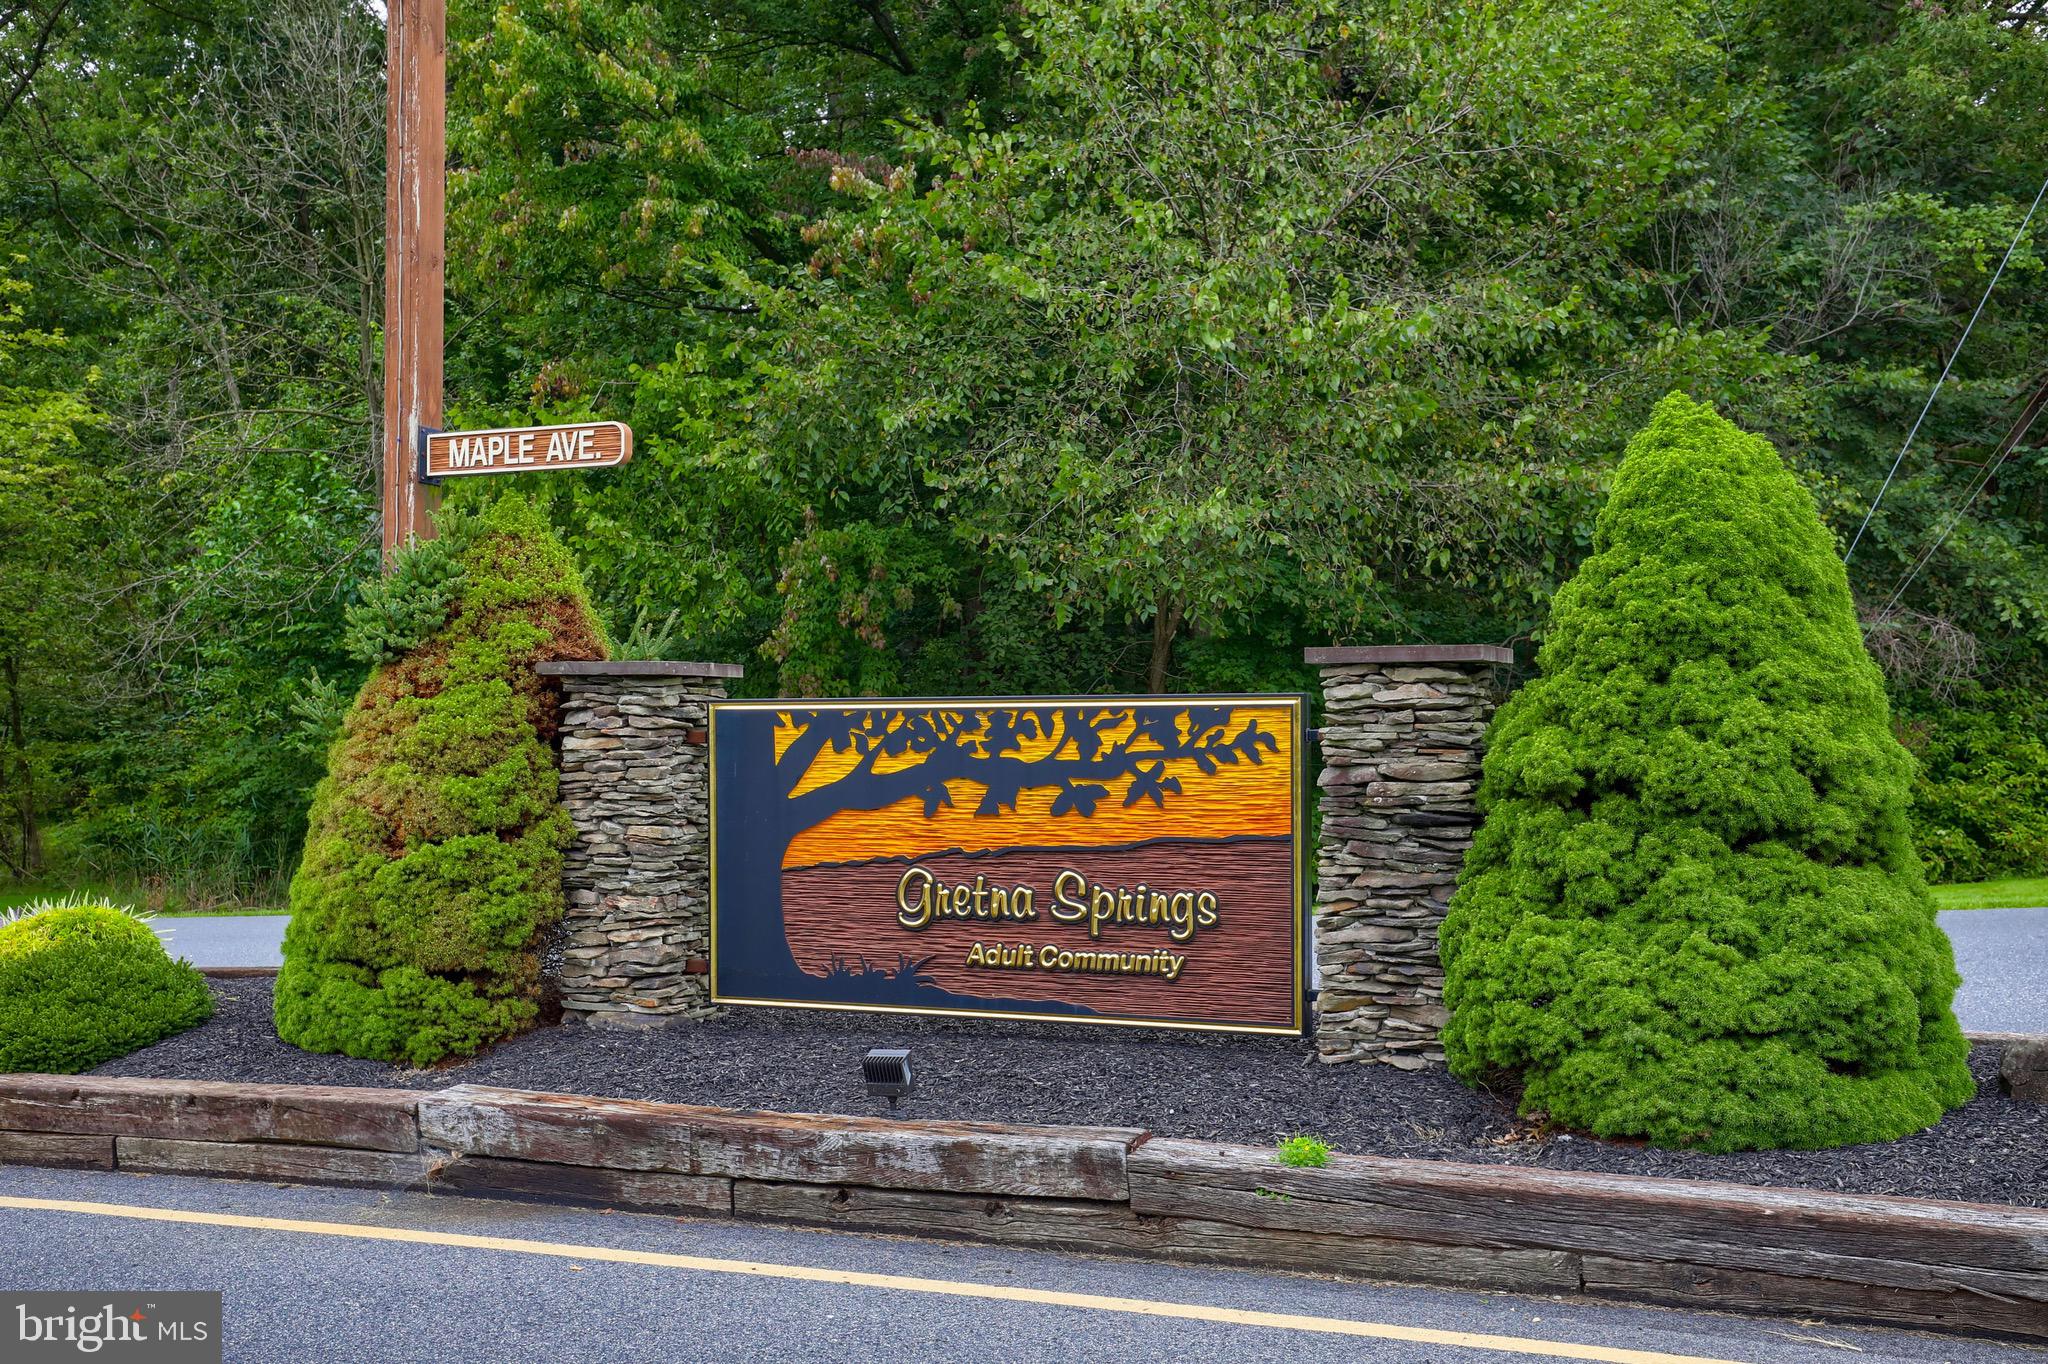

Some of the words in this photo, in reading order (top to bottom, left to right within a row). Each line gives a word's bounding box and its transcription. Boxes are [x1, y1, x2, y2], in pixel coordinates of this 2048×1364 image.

[448, 434, 535, 467] MAPLE
[545, 430, 602, 462] AVE.
[897, 867, 1036, 928] Gretna
[1049, 870, 1217, 938] Springs
[966, 942, 1032, 968] Adult
[1038, 944, 1185, 980] Community
